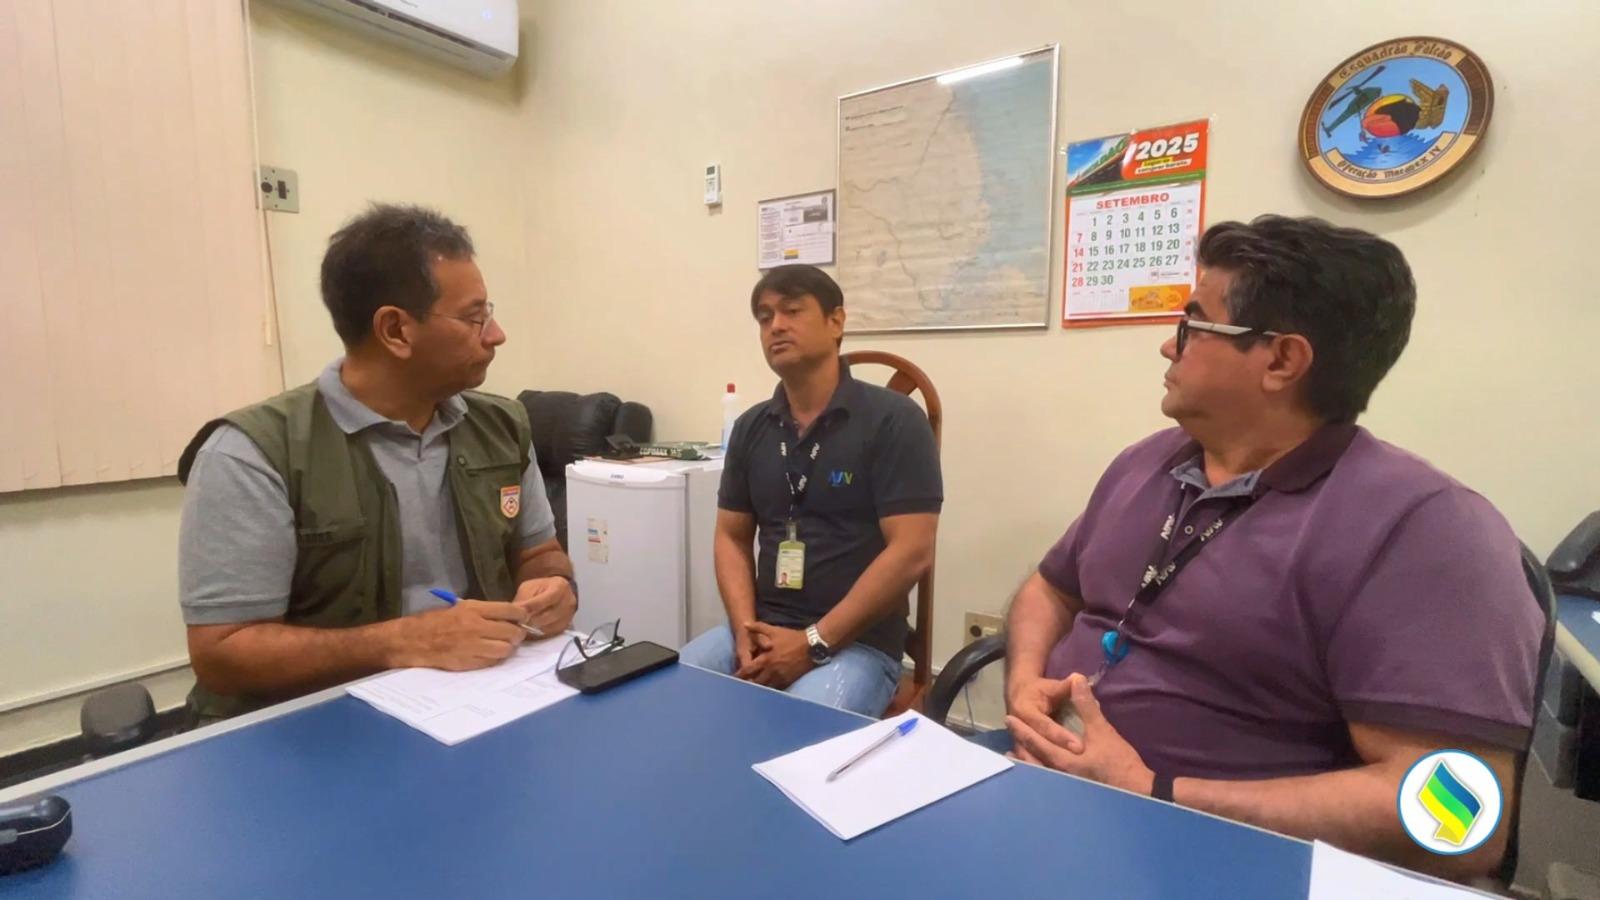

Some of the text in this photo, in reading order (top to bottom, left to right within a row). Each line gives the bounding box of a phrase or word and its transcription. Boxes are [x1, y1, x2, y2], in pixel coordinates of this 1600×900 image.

[1135, 132, 1200, 160] 2025
[1096, 192, 1170, 209] SETEMBRO
[1092, 208, 1177, 227] 1 2 3 4 5 6
[1077, 223, 1180, 243] 7 8 9 10 11 12 13
[1074, 239, 1180, 257] 14 15 16 17 18 19 20
[1072, 255, 1179, 272] 21 22 23 24 25 26 27
[1072, 275, 1113, 287] 28 29 30
